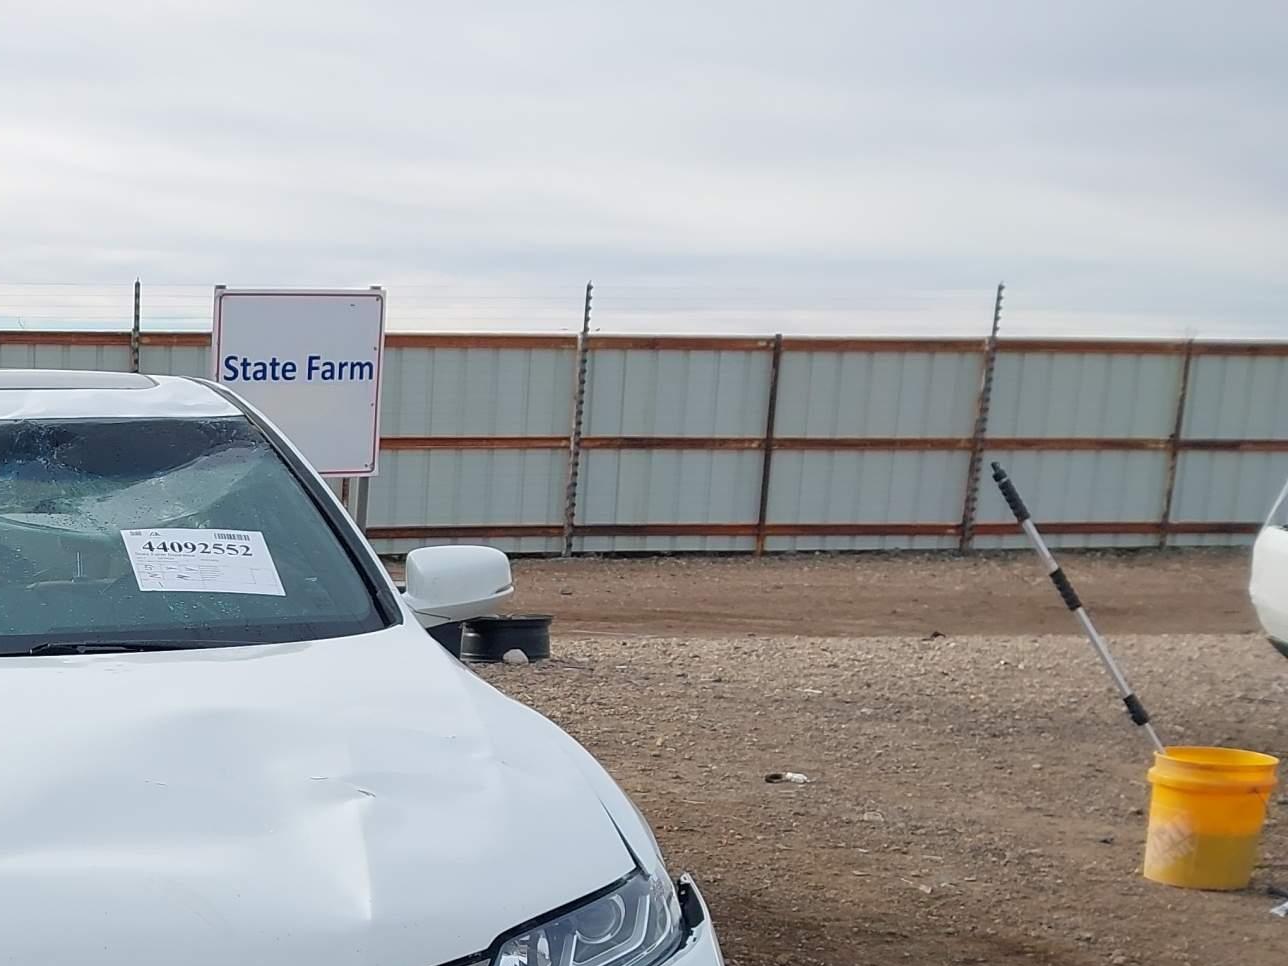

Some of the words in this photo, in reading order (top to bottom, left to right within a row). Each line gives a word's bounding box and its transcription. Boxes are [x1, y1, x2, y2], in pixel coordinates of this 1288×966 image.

[223, 355, 297, 381] State
[307, 355, 374, 381] Farm
[142, 540, 253, 557] 44092552
